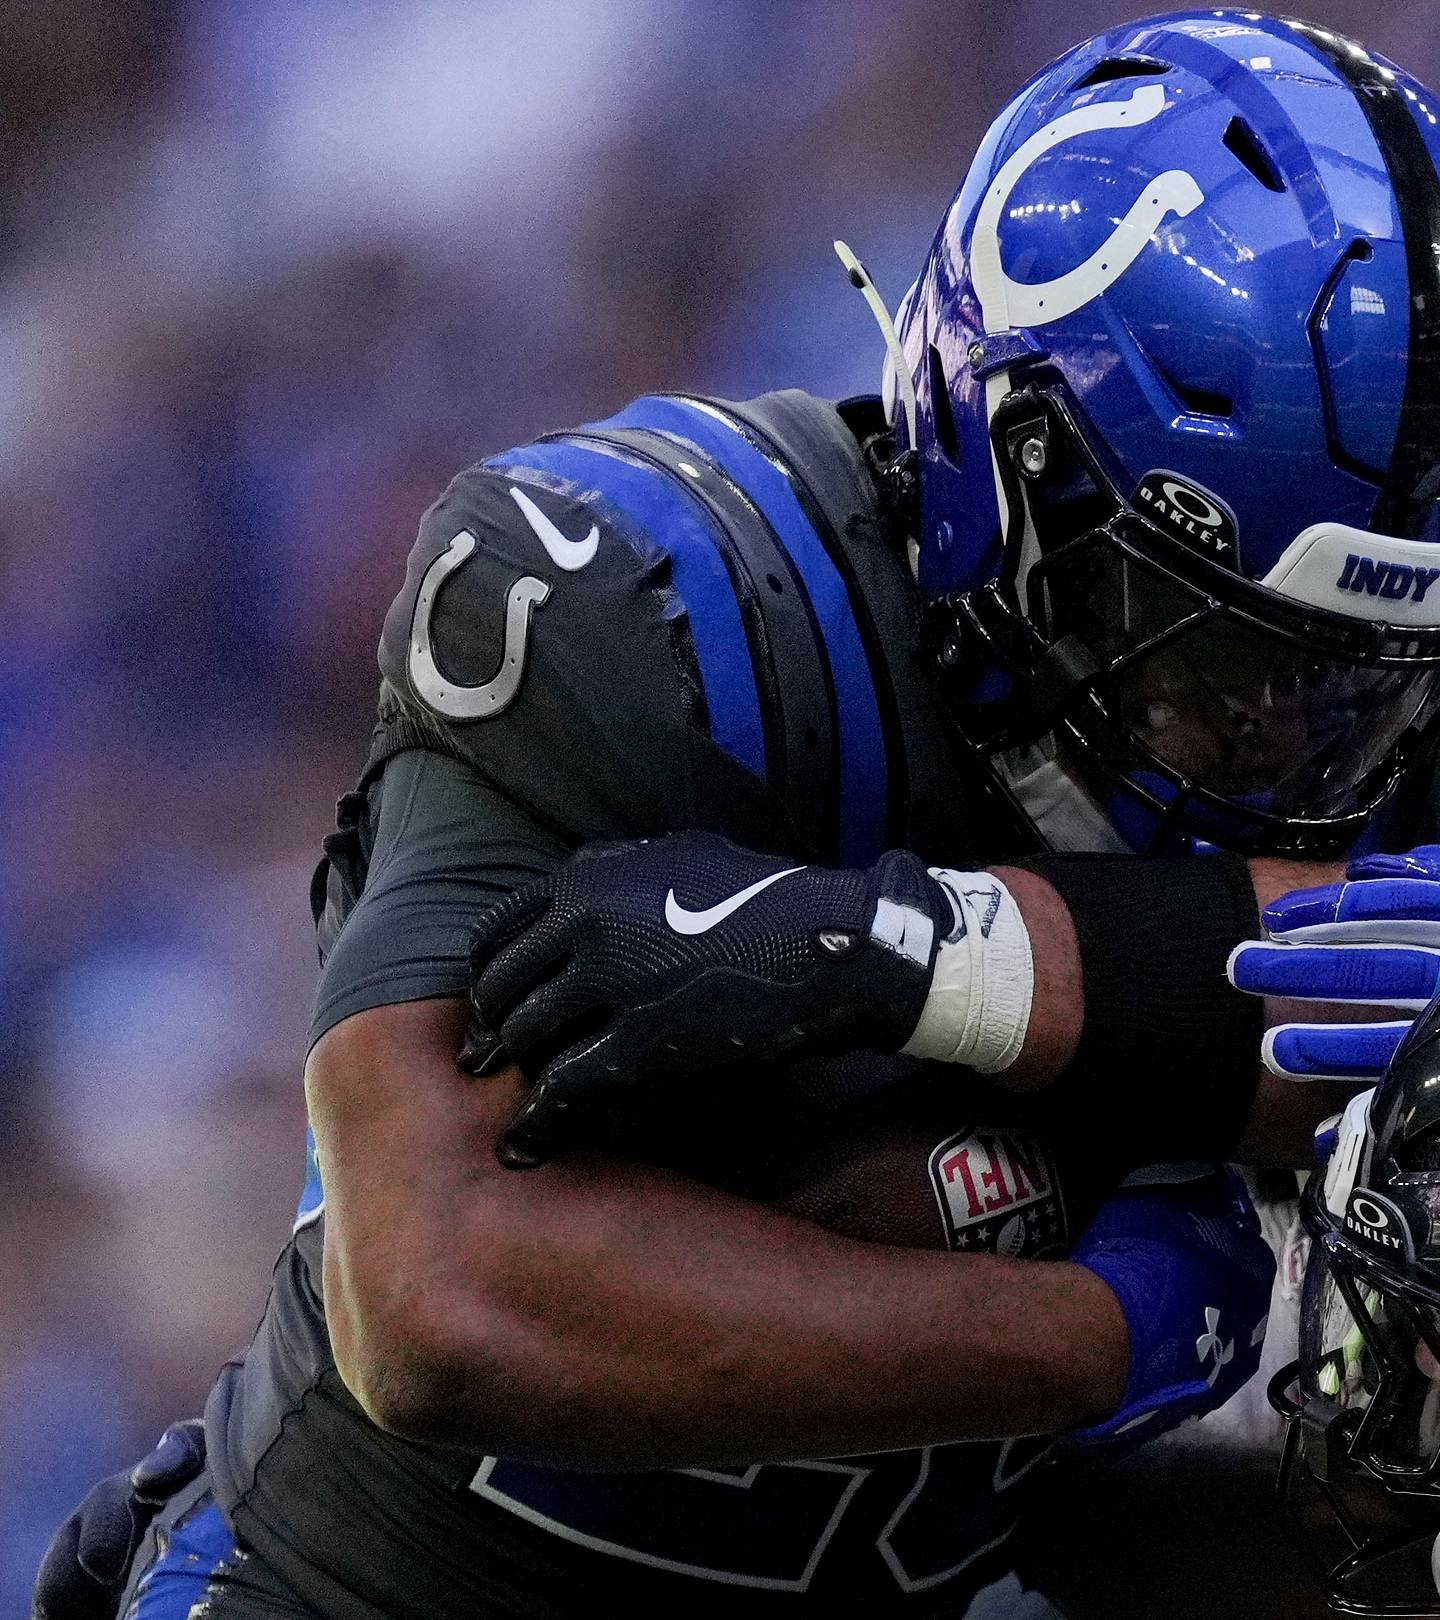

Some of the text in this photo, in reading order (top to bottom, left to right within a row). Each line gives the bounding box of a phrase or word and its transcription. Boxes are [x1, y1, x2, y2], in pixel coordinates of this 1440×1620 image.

[1140, 487, 1230, 552] OAKLEY
[1336, 553, 1440, 603] INDY
[942, 1135, 1048, 1219] NFL
[1347, 1216, 1400, 1249] OAKLEY
